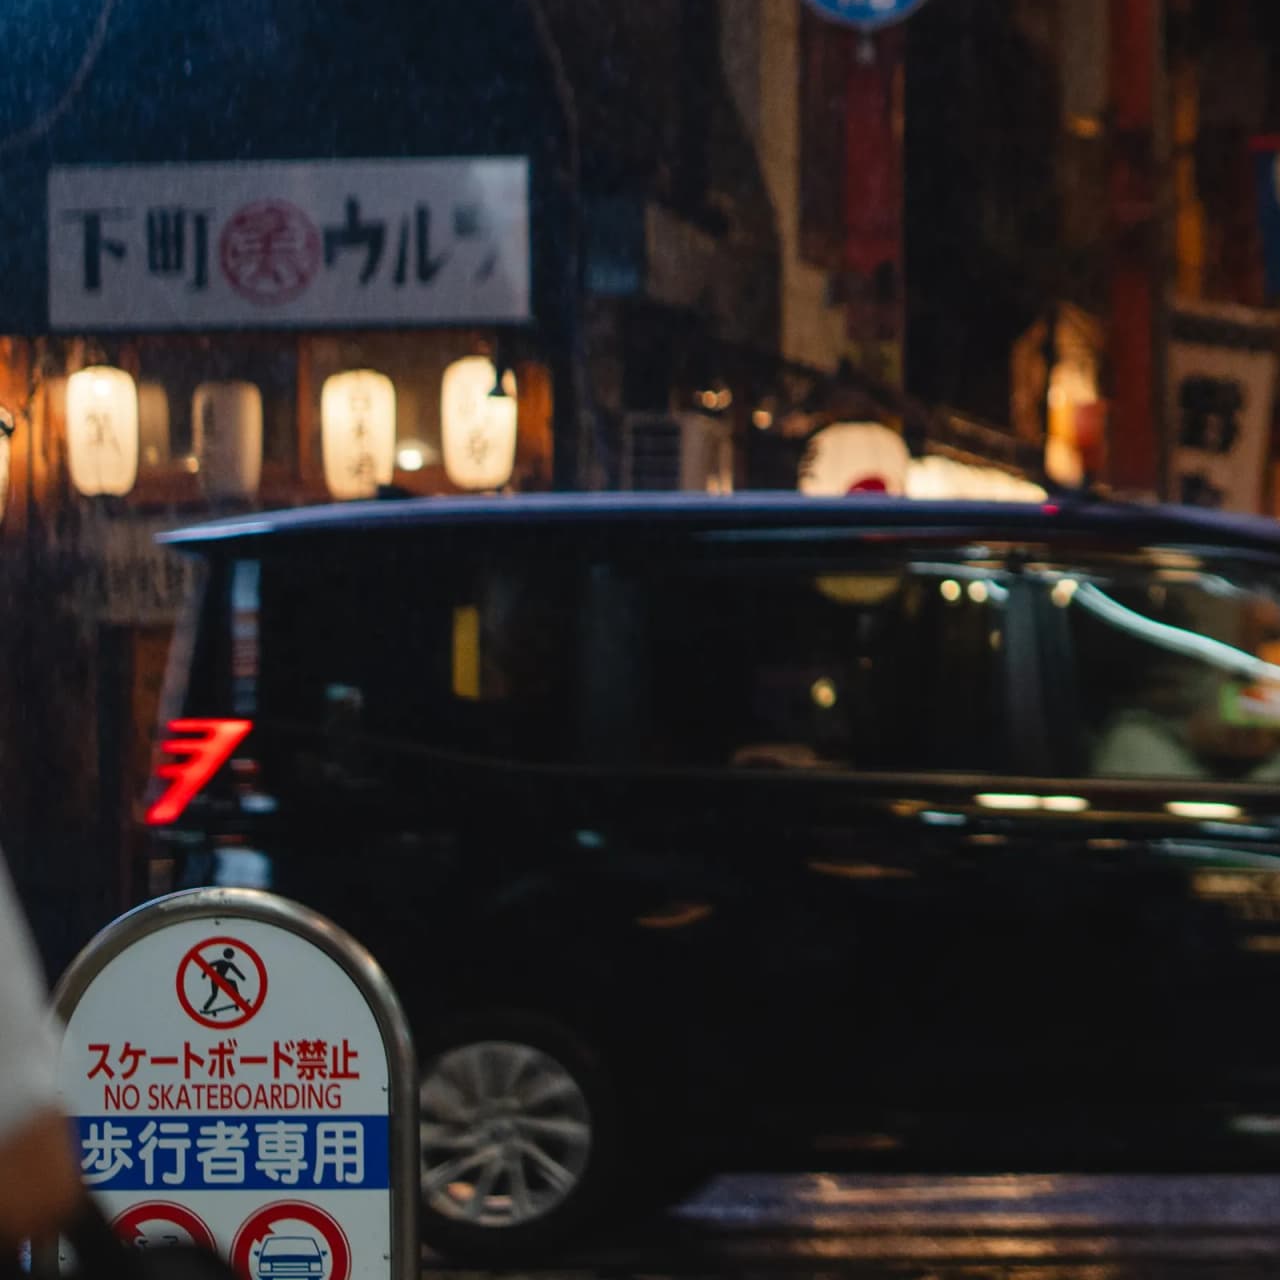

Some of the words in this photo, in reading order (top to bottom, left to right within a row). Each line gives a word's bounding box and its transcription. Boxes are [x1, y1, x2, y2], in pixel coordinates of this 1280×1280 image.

[86, 1039, 360, 1081] スケートボード禁止
[104, 1084, 140, 1110] NO
[147, 1083, 342, 1110] SKATEBOARDING
[80, 1120, 365, 1186] 歩行者専用
